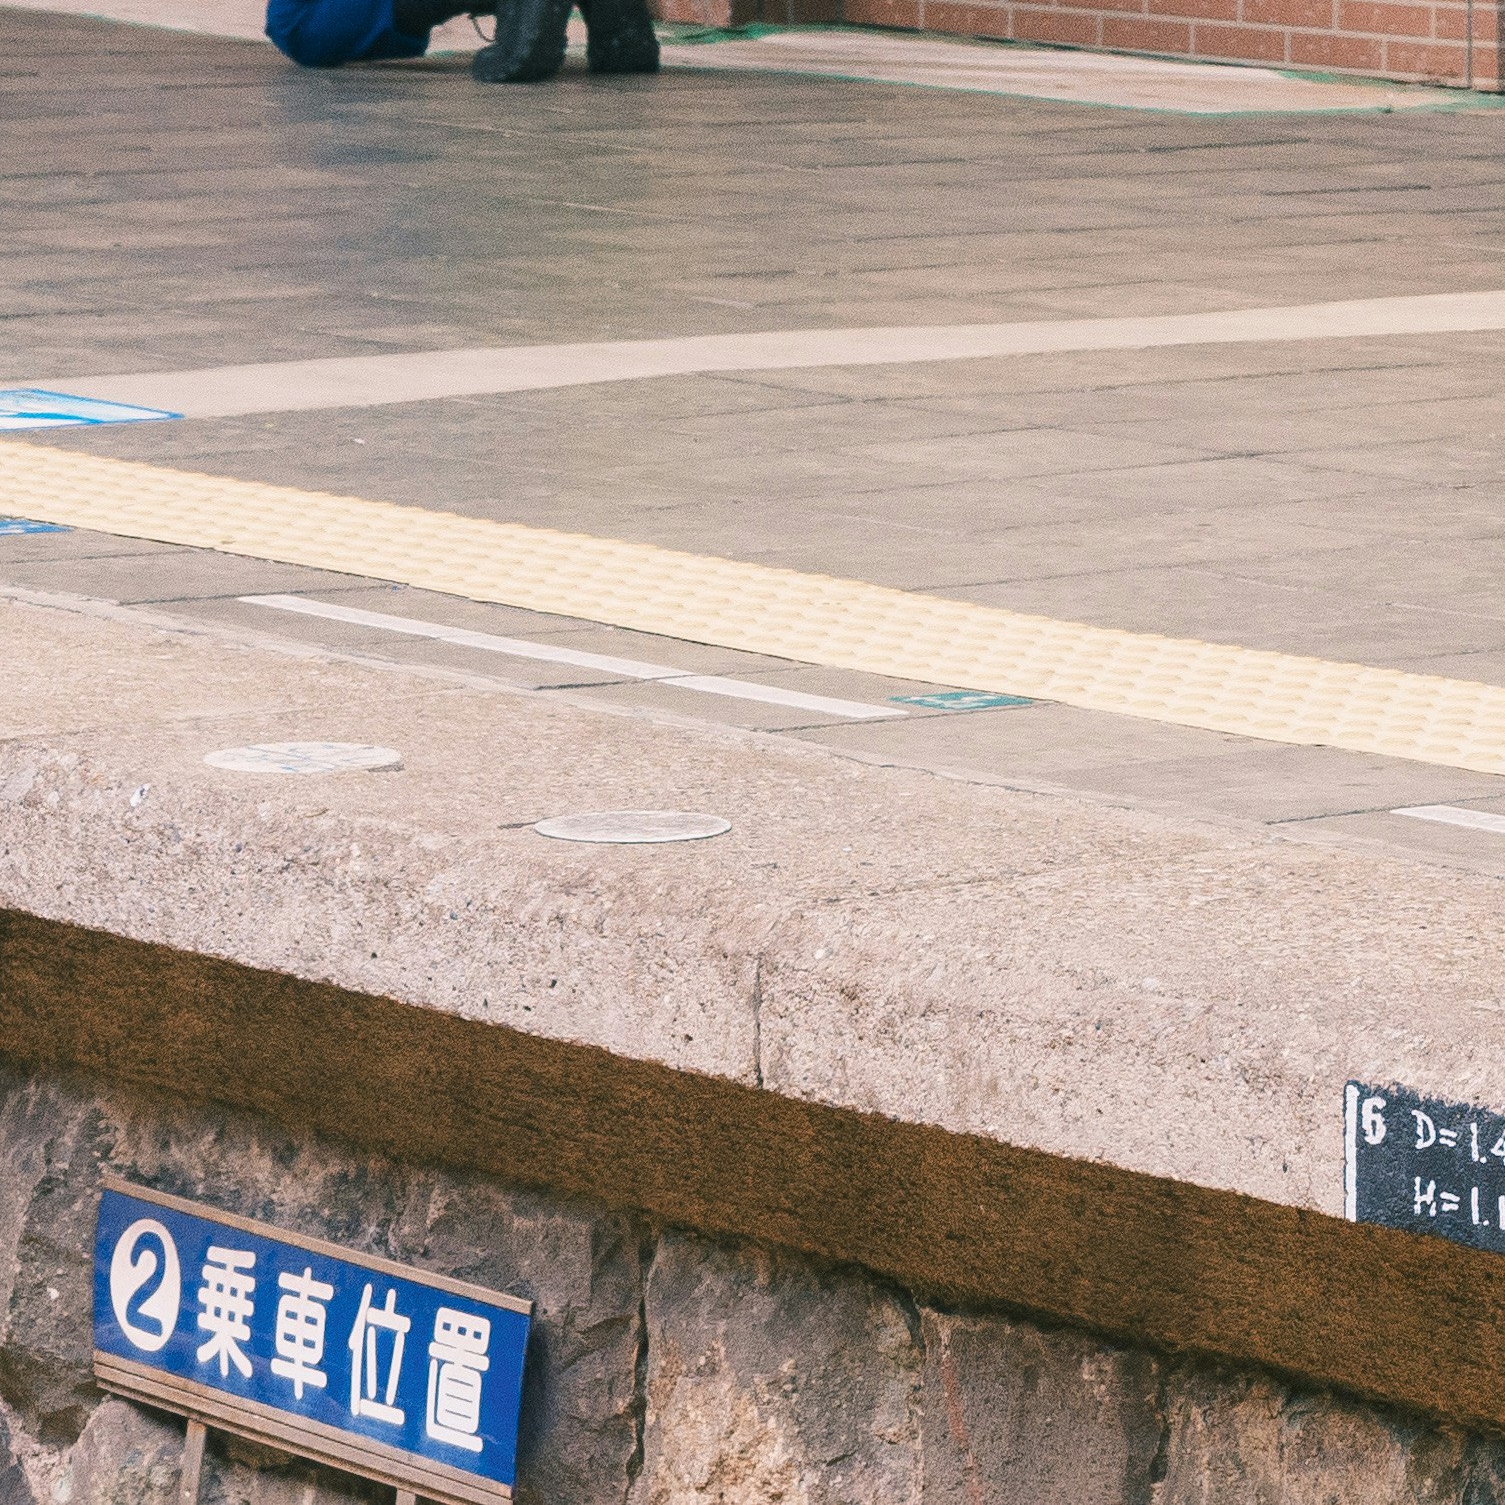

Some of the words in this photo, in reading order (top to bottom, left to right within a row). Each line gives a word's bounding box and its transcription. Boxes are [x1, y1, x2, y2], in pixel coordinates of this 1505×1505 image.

[1361, 1095, 1388, 1146] 6
[195, 1241, 493, 1453] 乗車位置
